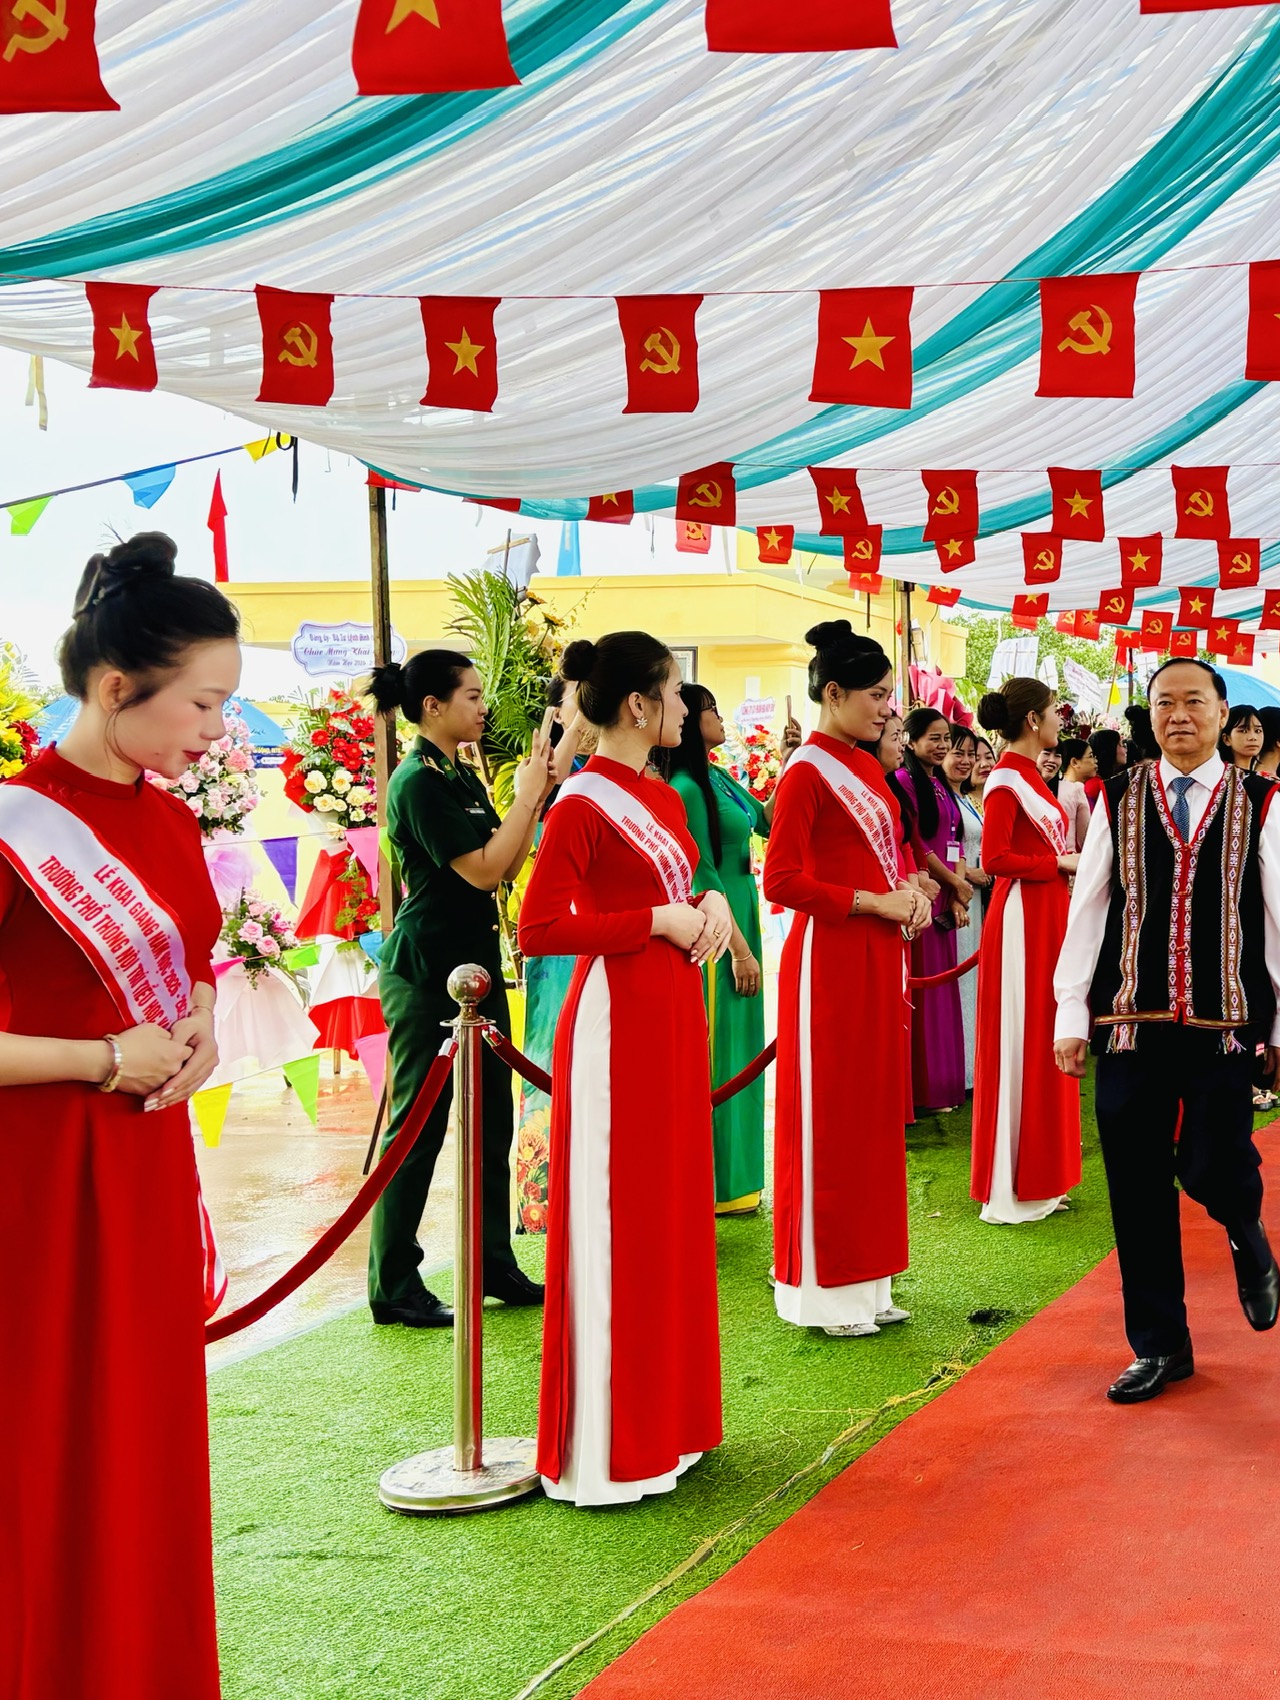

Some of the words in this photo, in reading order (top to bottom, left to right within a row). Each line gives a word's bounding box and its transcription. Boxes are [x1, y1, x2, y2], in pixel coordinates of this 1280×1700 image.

[37, 855, 84, 903] TRƯỜNG
[72, 892, 111, 922] PHỔ
[92, 914, 130, 954] THÔNG
[115, 945, 140, 972] NỘI
[106, 876, 137, 907] KHAI
[128, 901, 160, 937] GIẢNG
[147, 930, 171, 960] NĂM
